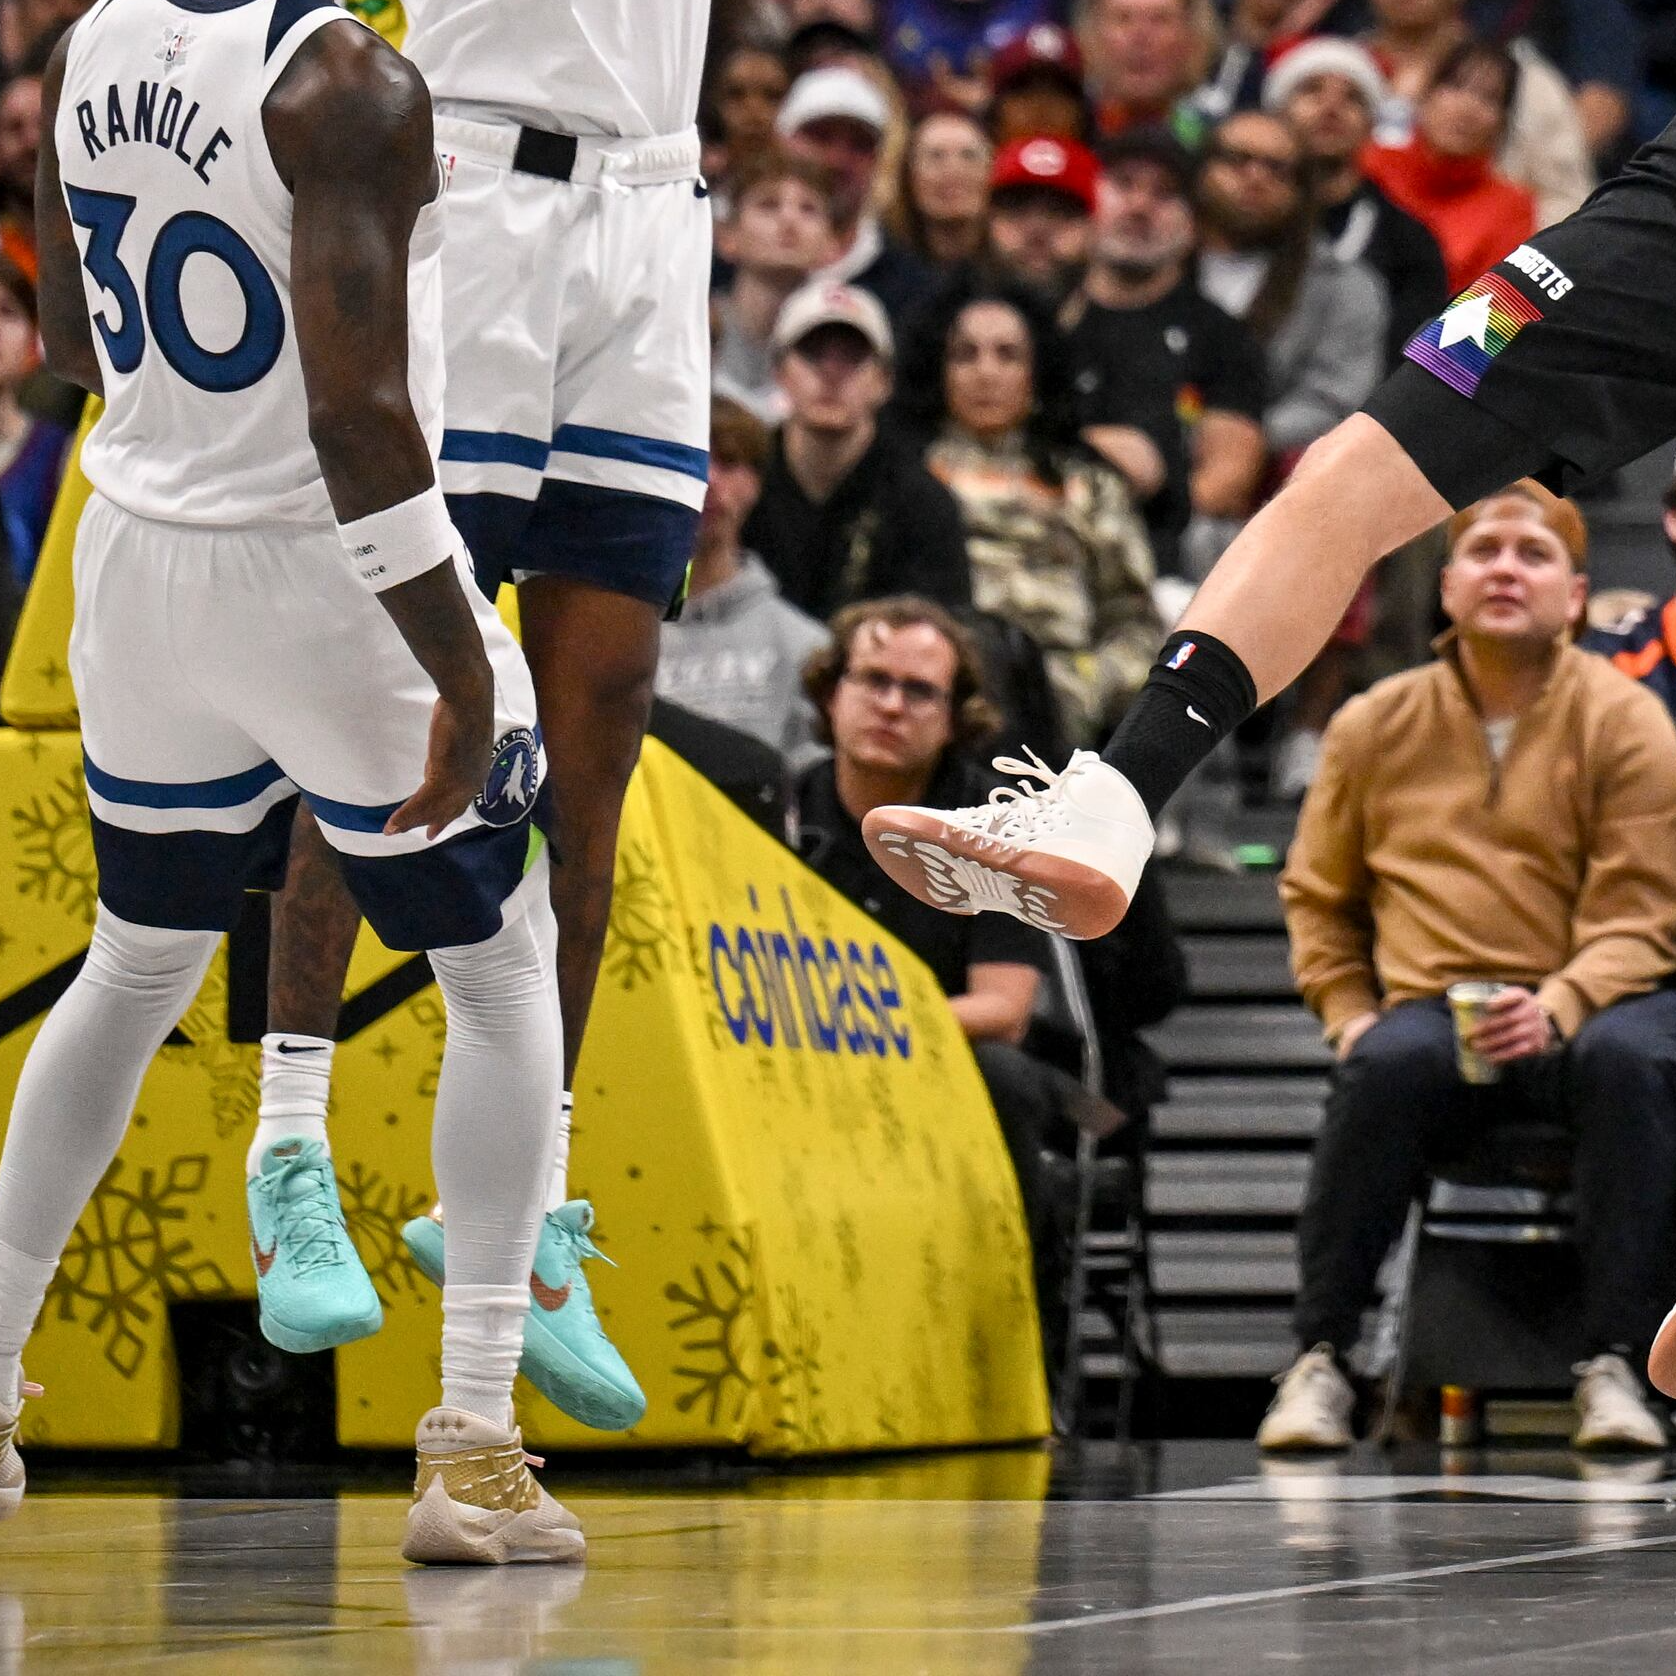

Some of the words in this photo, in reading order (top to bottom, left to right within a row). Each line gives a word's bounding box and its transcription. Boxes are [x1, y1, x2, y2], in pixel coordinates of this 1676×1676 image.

[76, 80, 232, 186] RANDLE
[64, 180, 286, 393] 30
[710, 883, 911, 1060] coinbase
